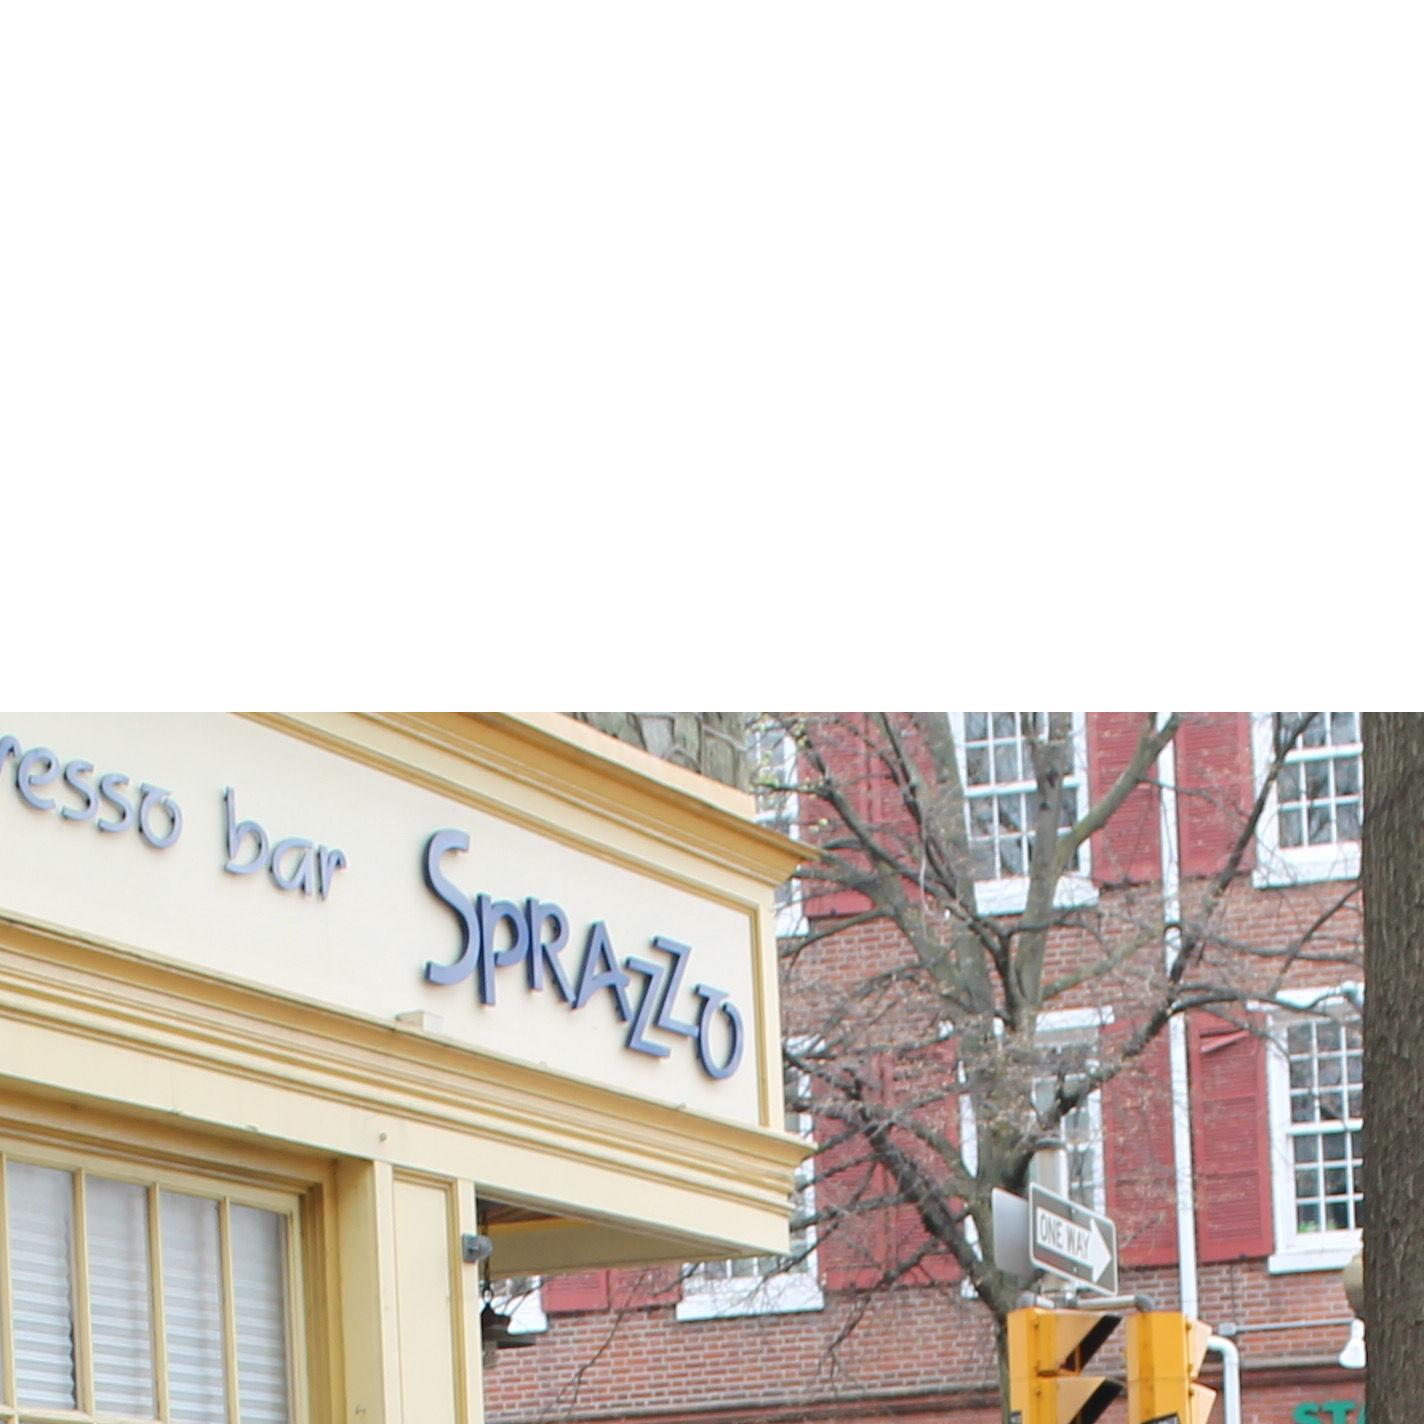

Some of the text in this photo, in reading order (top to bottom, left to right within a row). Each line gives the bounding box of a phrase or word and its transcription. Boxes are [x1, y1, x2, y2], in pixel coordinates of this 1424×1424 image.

[223, 786, 347, 902] bar
[1040, 1213, 1090, 1261] ONE WAY
